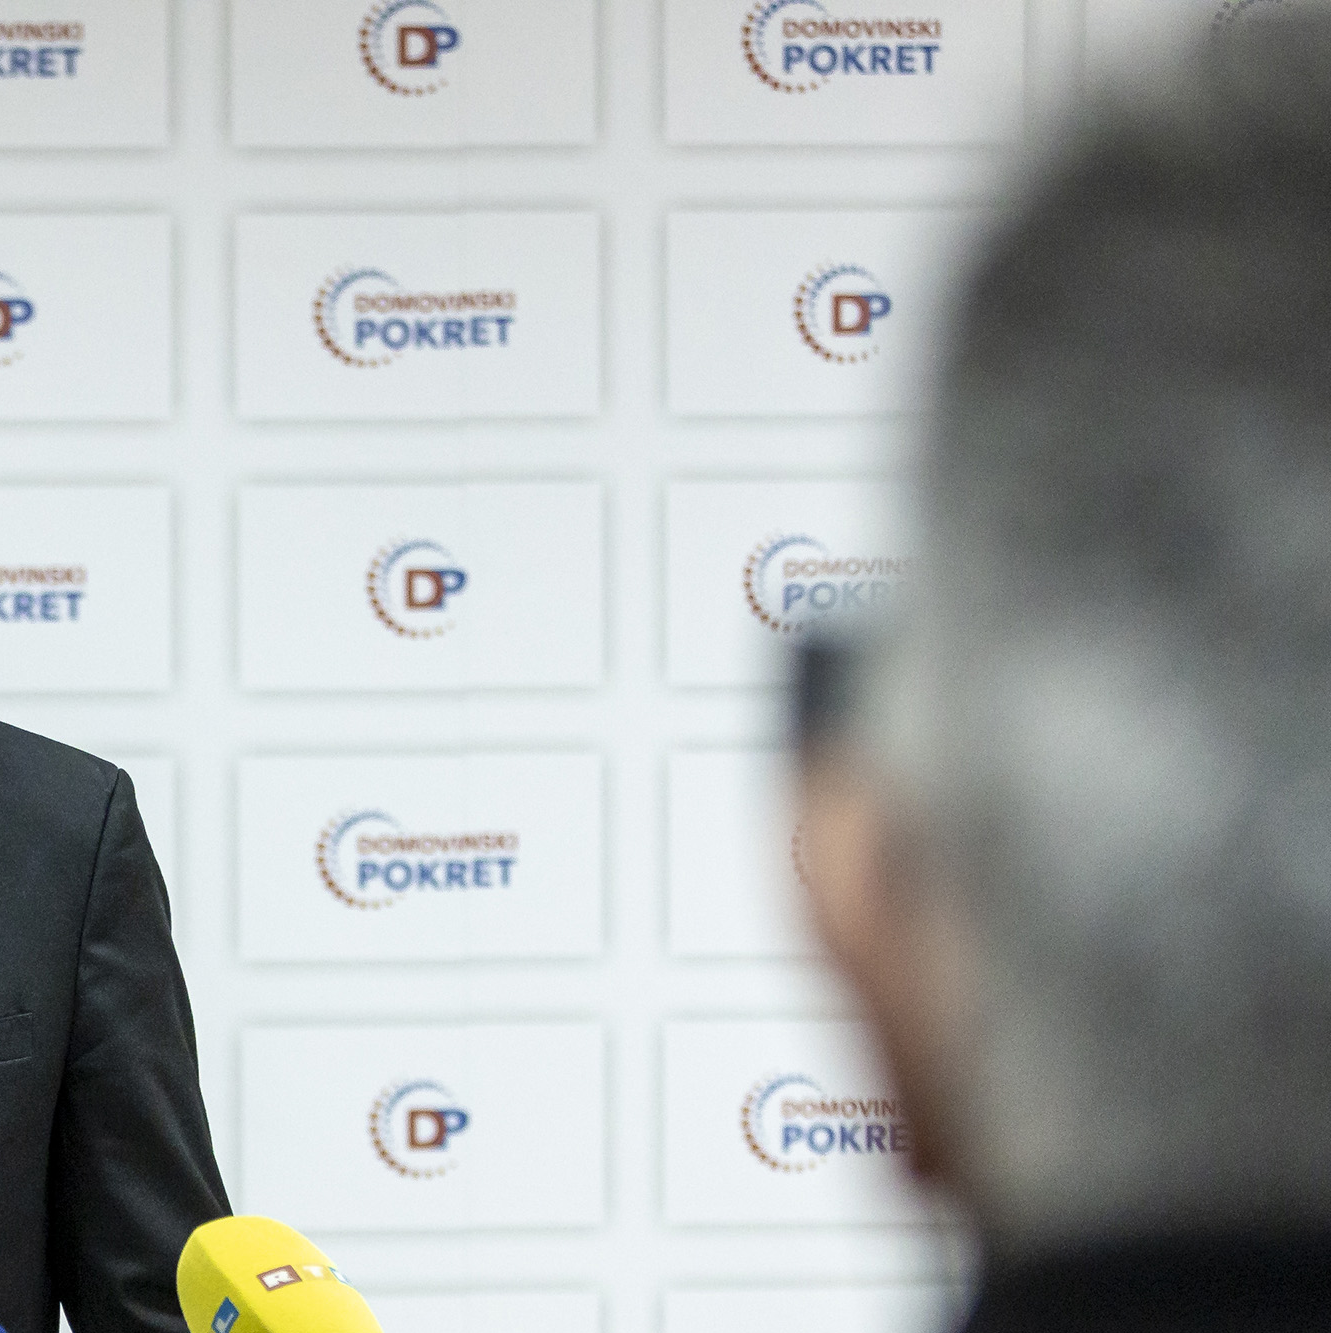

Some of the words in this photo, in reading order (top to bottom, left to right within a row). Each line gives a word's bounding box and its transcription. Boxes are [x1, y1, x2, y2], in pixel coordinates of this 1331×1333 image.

[782, 19, 941, 38] DOMOVINSKI
[397, 25, 462, 67] DP
[782, 44, 941, 75] POKRET
[354, 290, 516, 312] DOMOVINSKI
[831, 293, 891, 336] DP
[354, 316, 513, 349] POKRET
[405, 568, 467, 609] DP
[357, 832, 519, 854] DOMOVINSKI
[357, 857, 517, 890] POKRET
[781, 1098, 902, 1119] DOMOVIN
[408, 1107, 470, 1150] DP
[782, 1123, 912, 1155] POKRE
